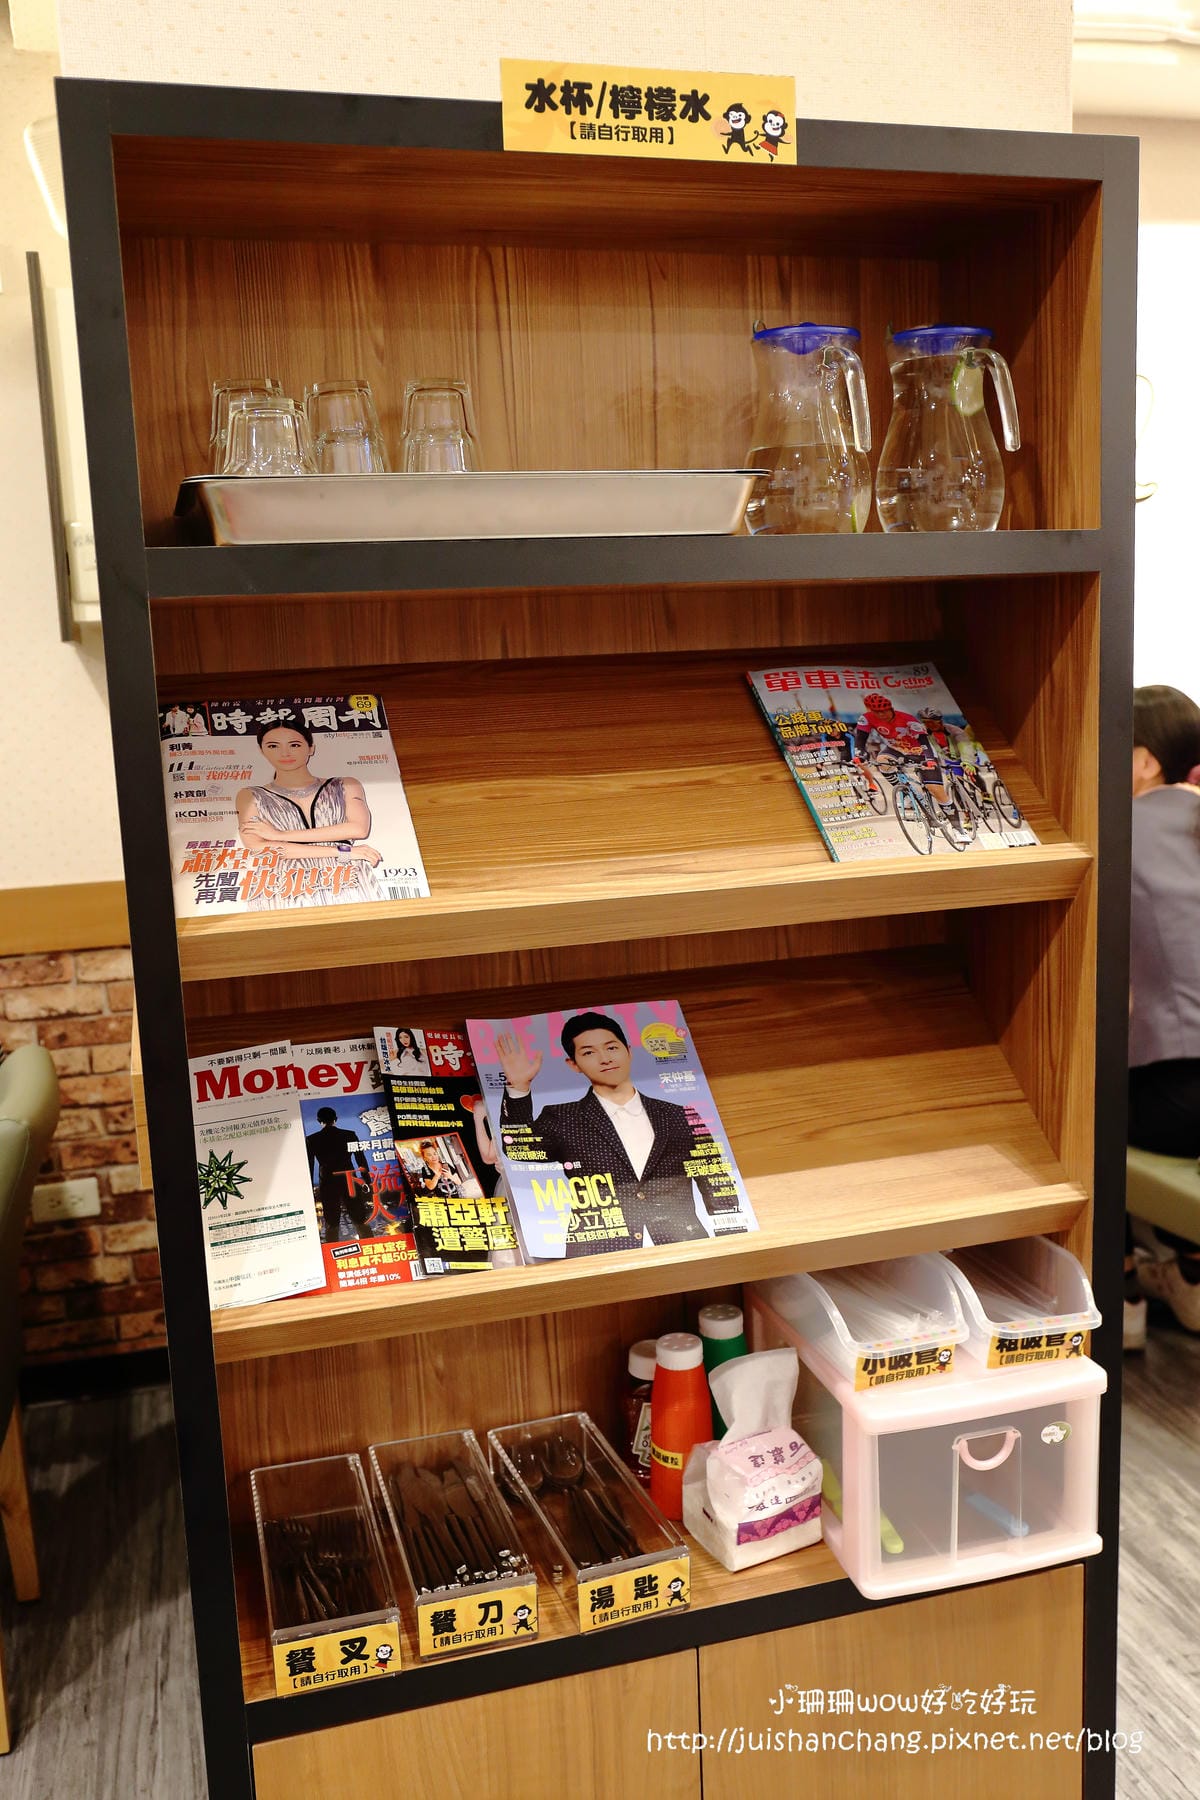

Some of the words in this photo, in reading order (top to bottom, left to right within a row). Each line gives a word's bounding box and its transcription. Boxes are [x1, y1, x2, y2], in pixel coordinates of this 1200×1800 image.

[524, 77, 713, 123] 水杯/檸檬水
[569, 120, 674, 145] 【請自行取用】
[763, 669, 881, 692] 單車誌
[883, 674, 934, 688] Cycling
[356, 701, 372, 709] 69
[774, 710, 824, 726] 公路車
[779, 721, 848, 739] 品牌Top10
[175, 810, 208, 818] iKON
[383, 867, 418, 878] 1993
[193, 1060, 368, 1103] Money
[332, 1163, 404, 1198] 下流
[530, 1172, 620, 1212] MAGIC!
[414, 1195, 509, 1227] 蕭亞軒
[999, 1347, 1060, 1366] 【請自行取用】
[868, 1365, 931, 1387] 【請自行取用】
[591, 1598, 660, 1625] 【請自行取用】
[432, 1624, 504, 1649] 【請自行取用】
[292, 1662, 369, 1690] 【請自行取用】
